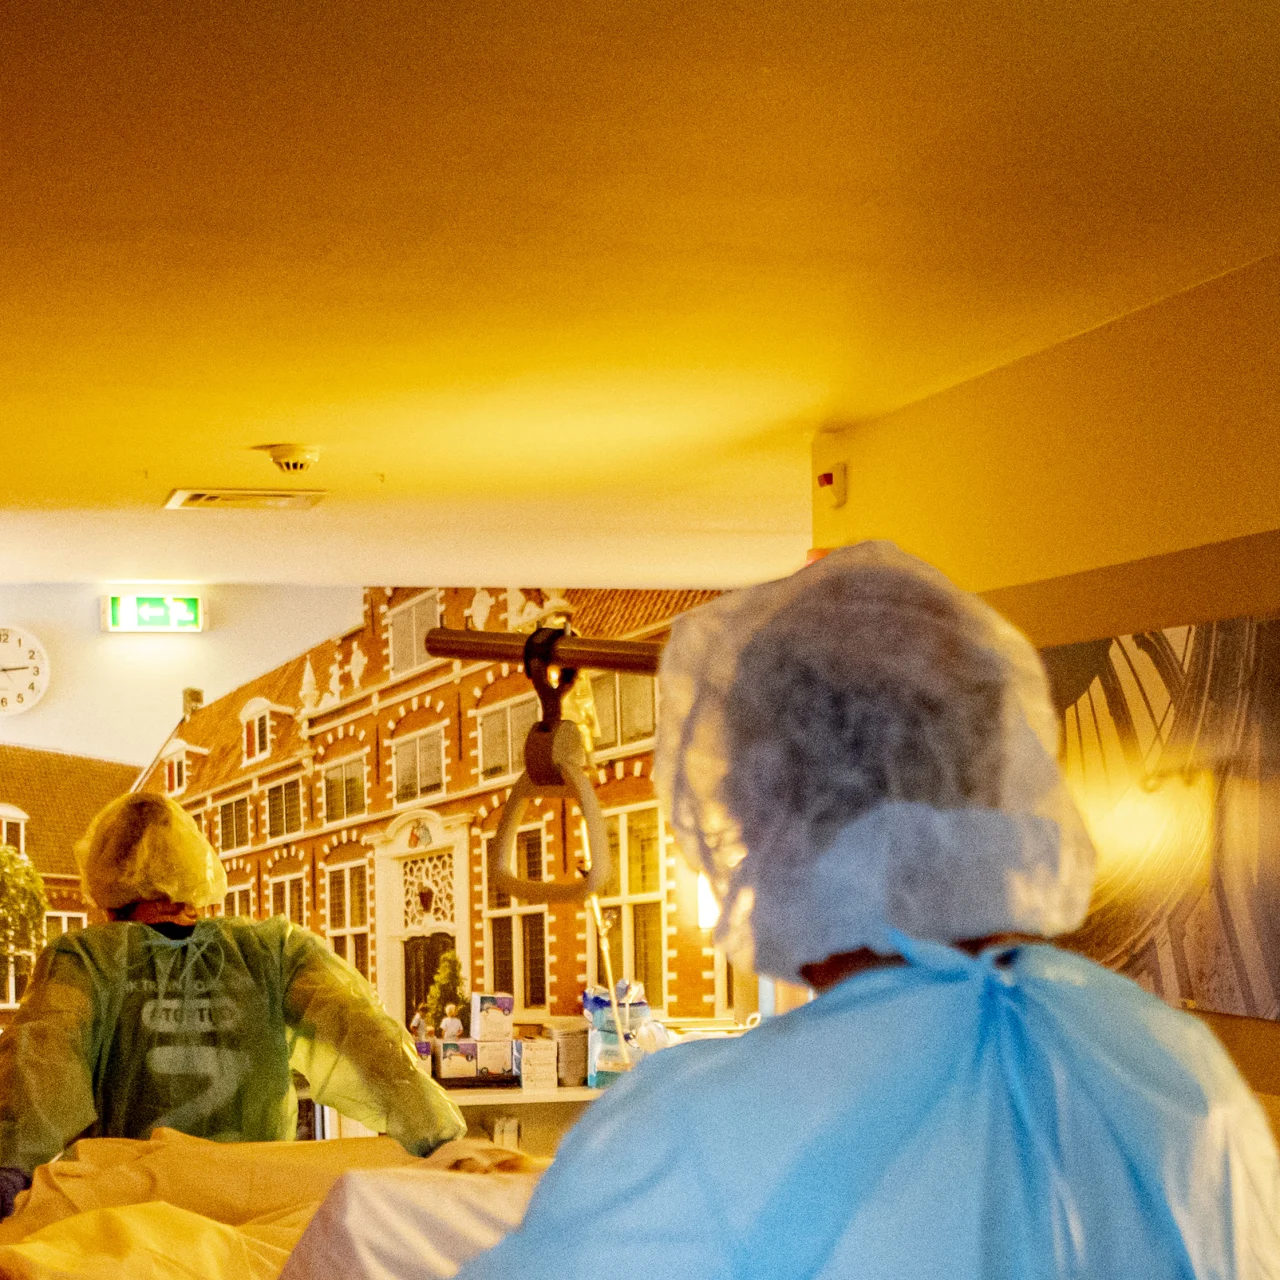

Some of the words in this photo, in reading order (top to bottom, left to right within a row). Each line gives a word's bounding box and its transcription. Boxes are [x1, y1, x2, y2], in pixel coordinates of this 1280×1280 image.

[28, 649, 36, 660] 2
[32, 666, 40, 677] 3
[28, 682, 35, 691] 4
[0, 697, 8, 707] 6
[16, 693, 24, 704] 5
